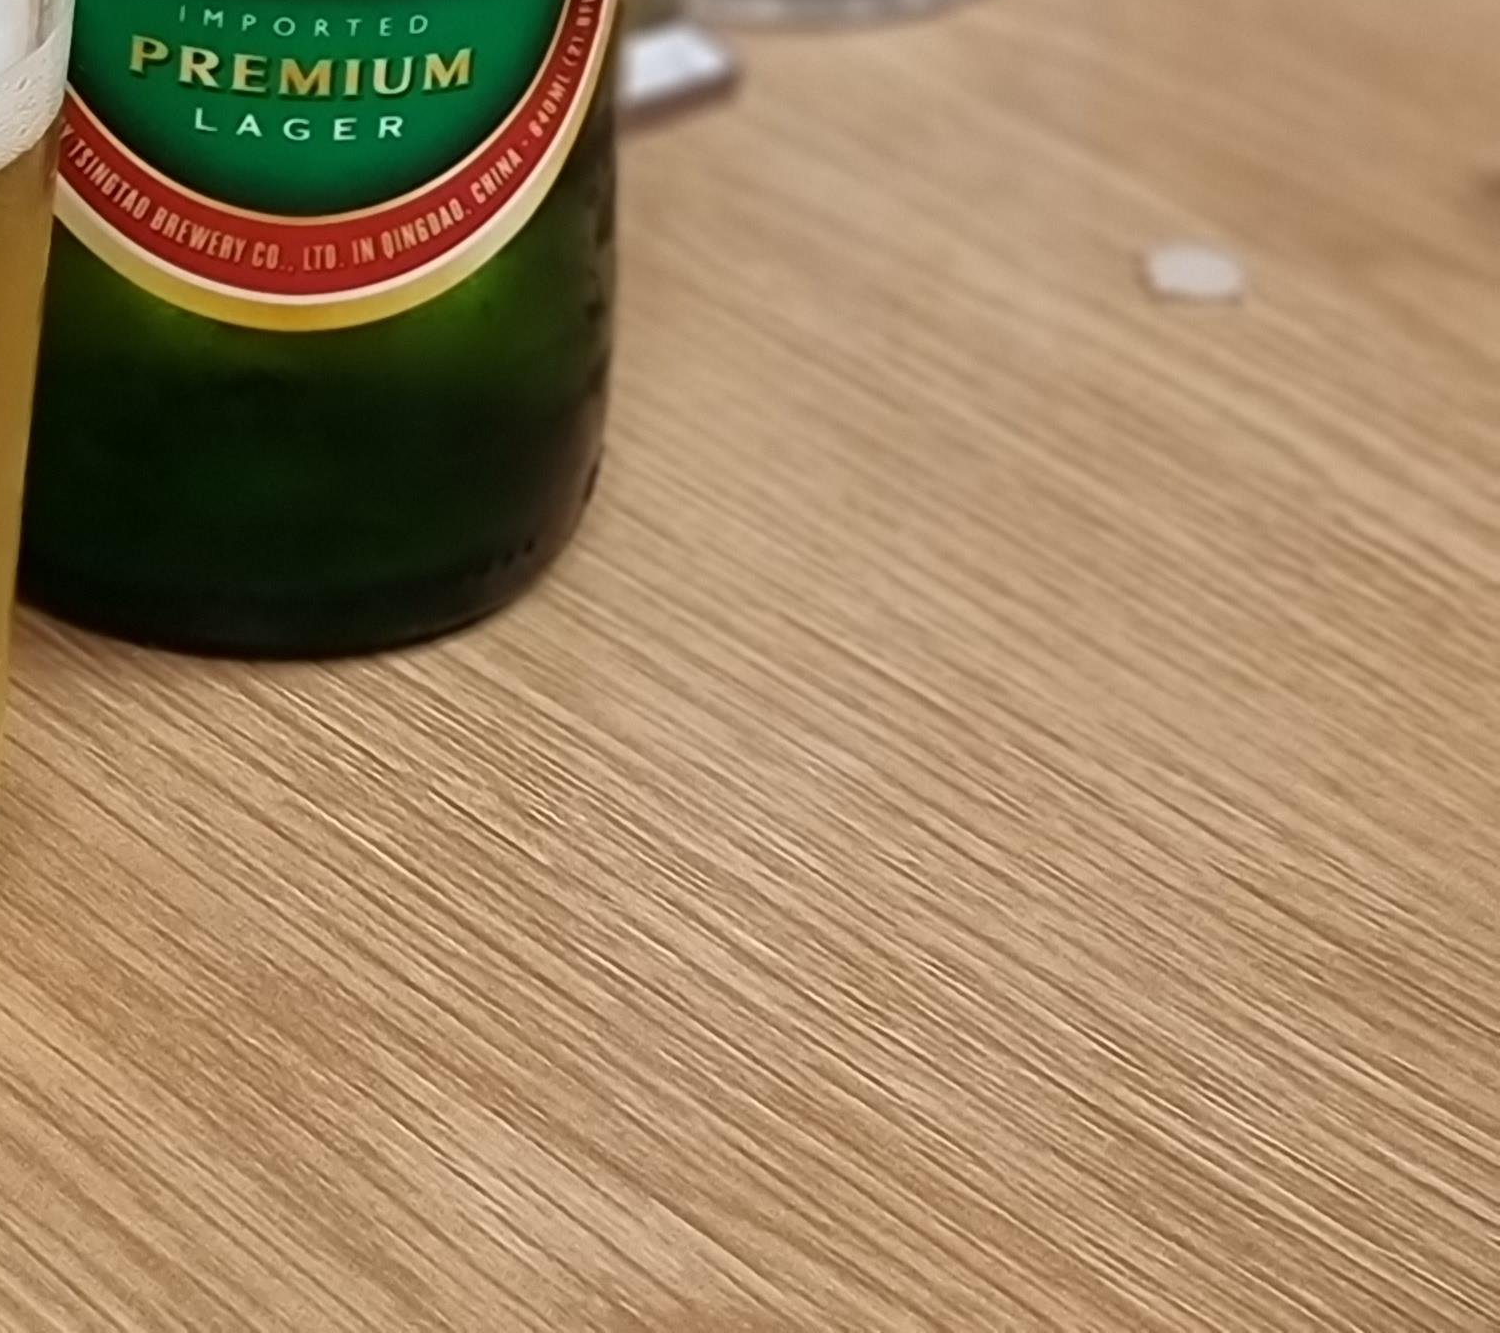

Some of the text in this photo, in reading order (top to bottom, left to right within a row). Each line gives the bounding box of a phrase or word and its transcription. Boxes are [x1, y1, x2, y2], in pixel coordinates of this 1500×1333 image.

[178, 4, 429, 38] IMPORTED
[128, 33, 474, 98] PREMIUM
[193, 106, 405, 142] LAGER
[67, 138, 152, 221] TSINGTAO
[149, 205, 248, 264] BREWERY
[352, 236, 376, 265] IN
[469, 146, 524, 205] CHINA
